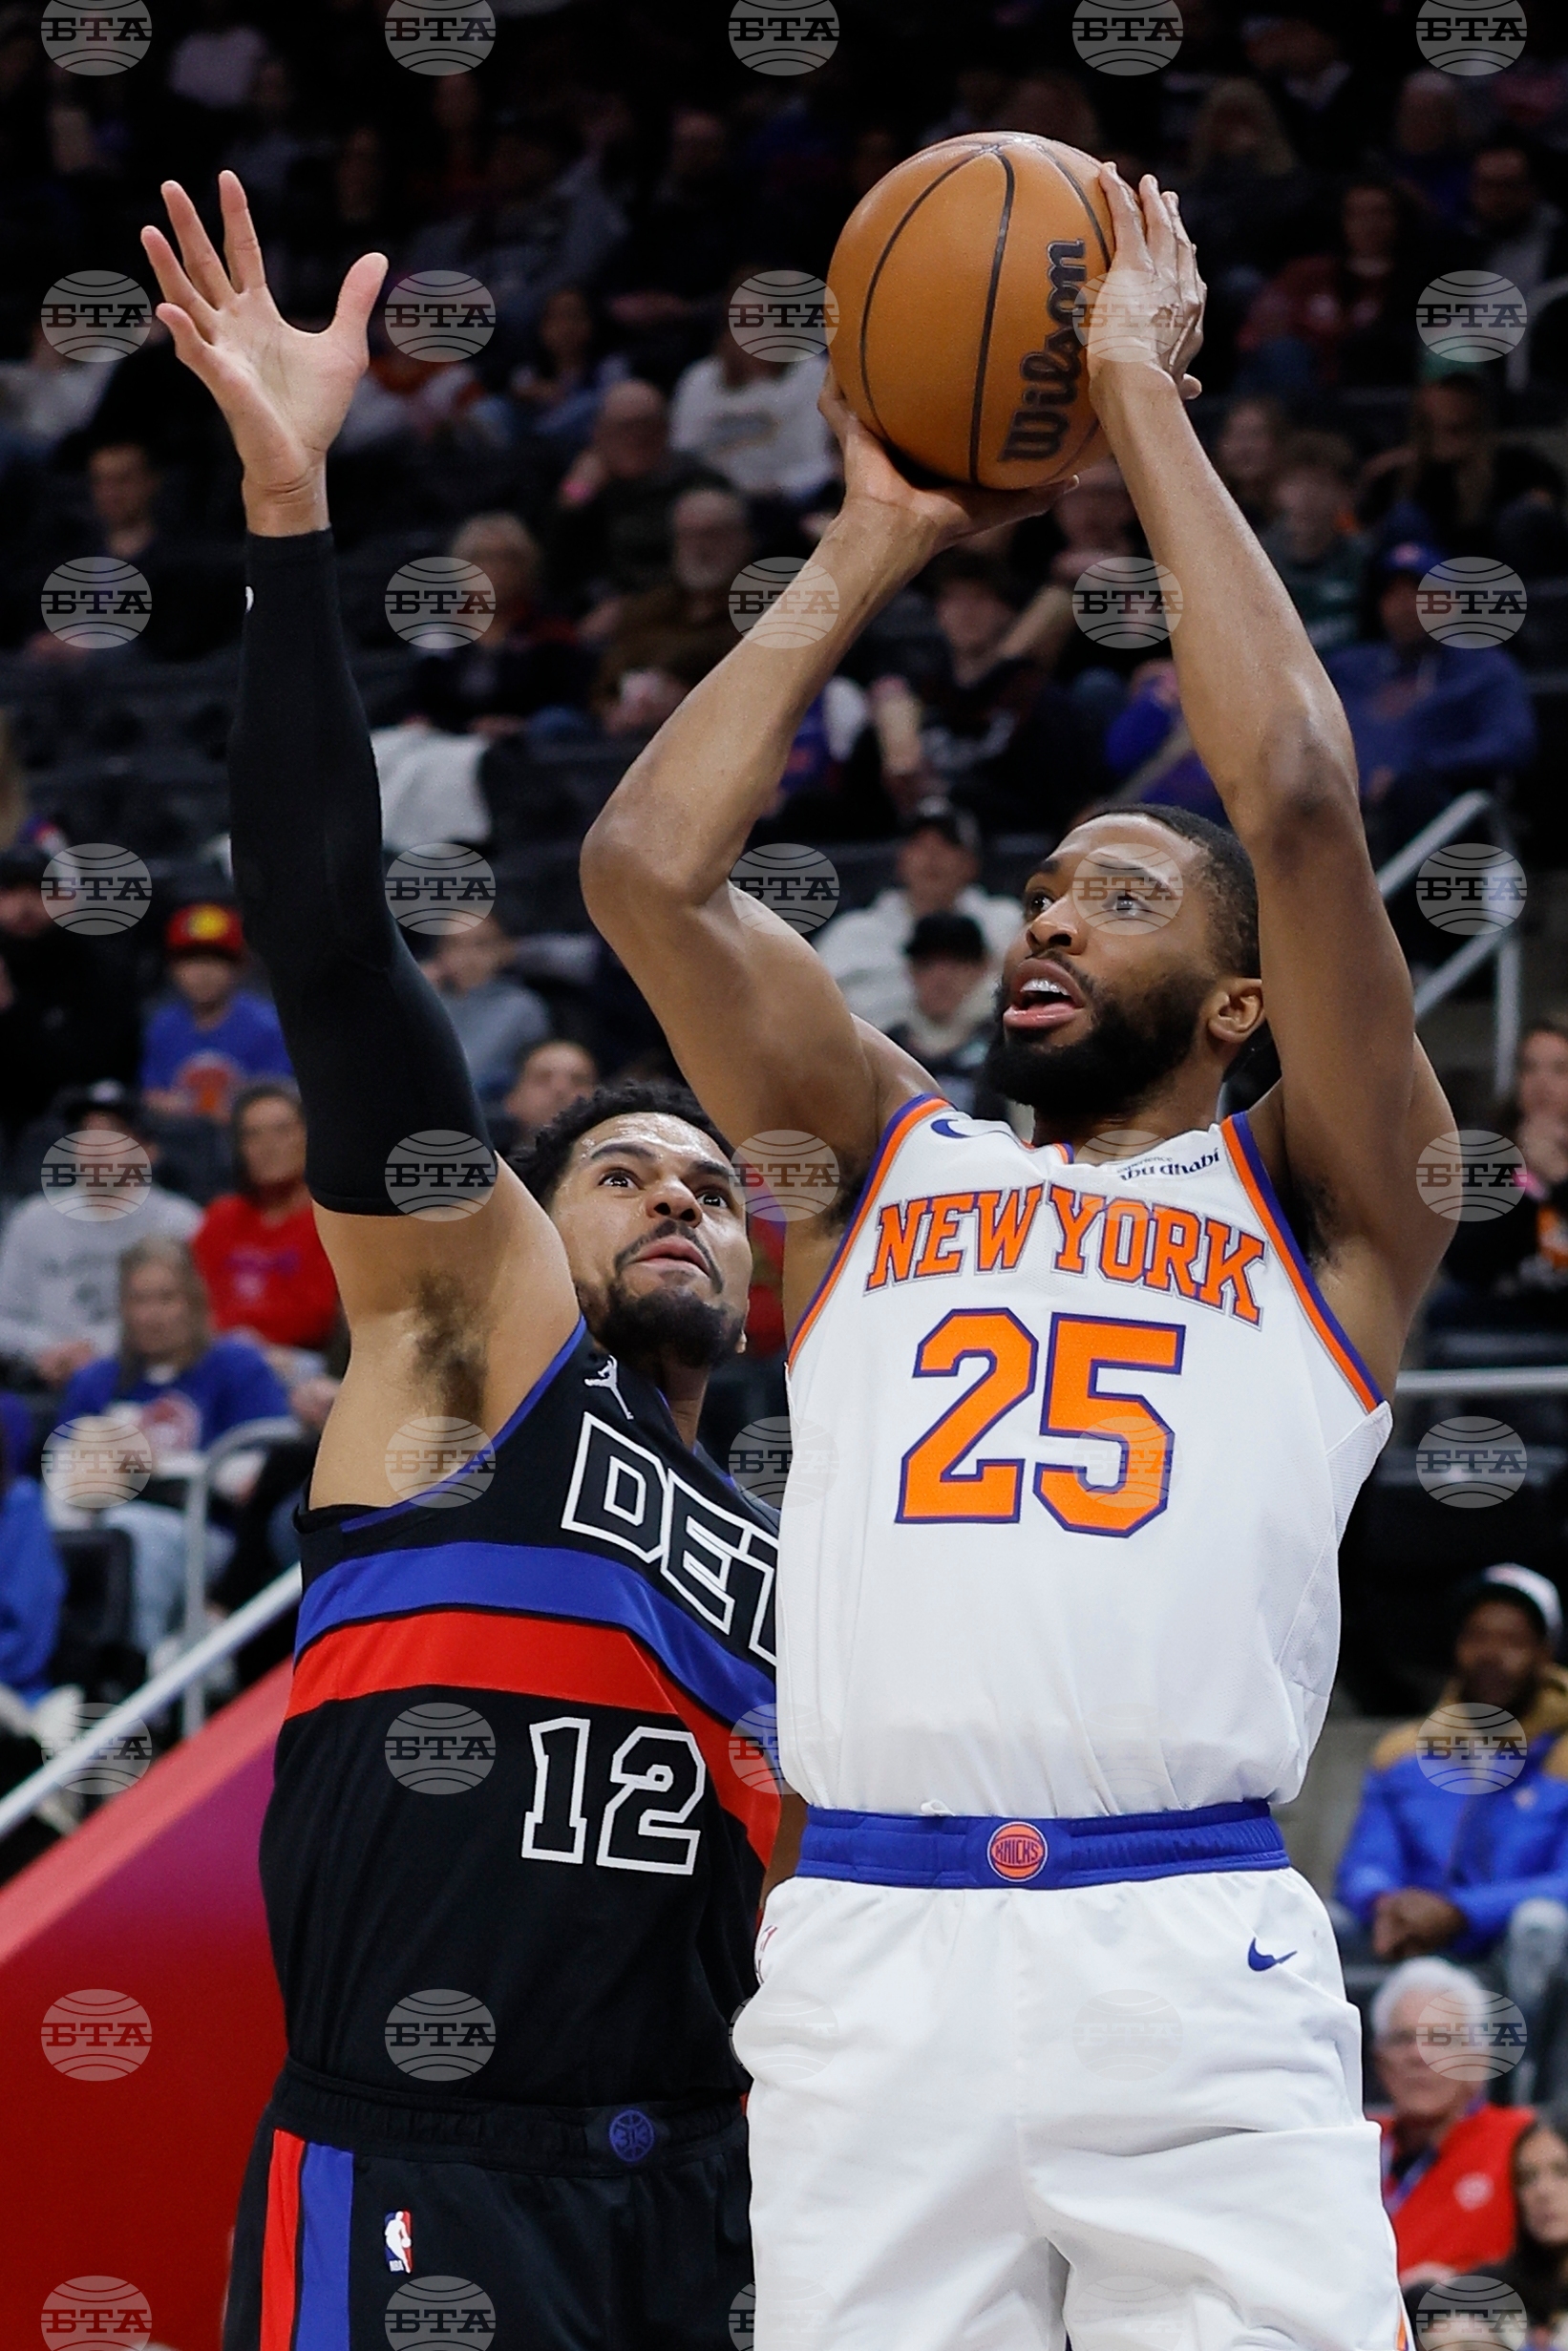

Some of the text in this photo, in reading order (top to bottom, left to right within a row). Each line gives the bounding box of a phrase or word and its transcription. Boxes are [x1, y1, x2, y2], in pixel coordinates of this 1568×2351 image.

[997, 239, 1086, 462] Wilson
[1159, 1148, 1220, 1176] dhabi
[863, 1181, 1266, 1329] NEW YORK
[895, 1307, 1186, 1538] 25
[521, 1716, 706, 1875] 12
[995, 1838, 1039, 1865] KNICKS
